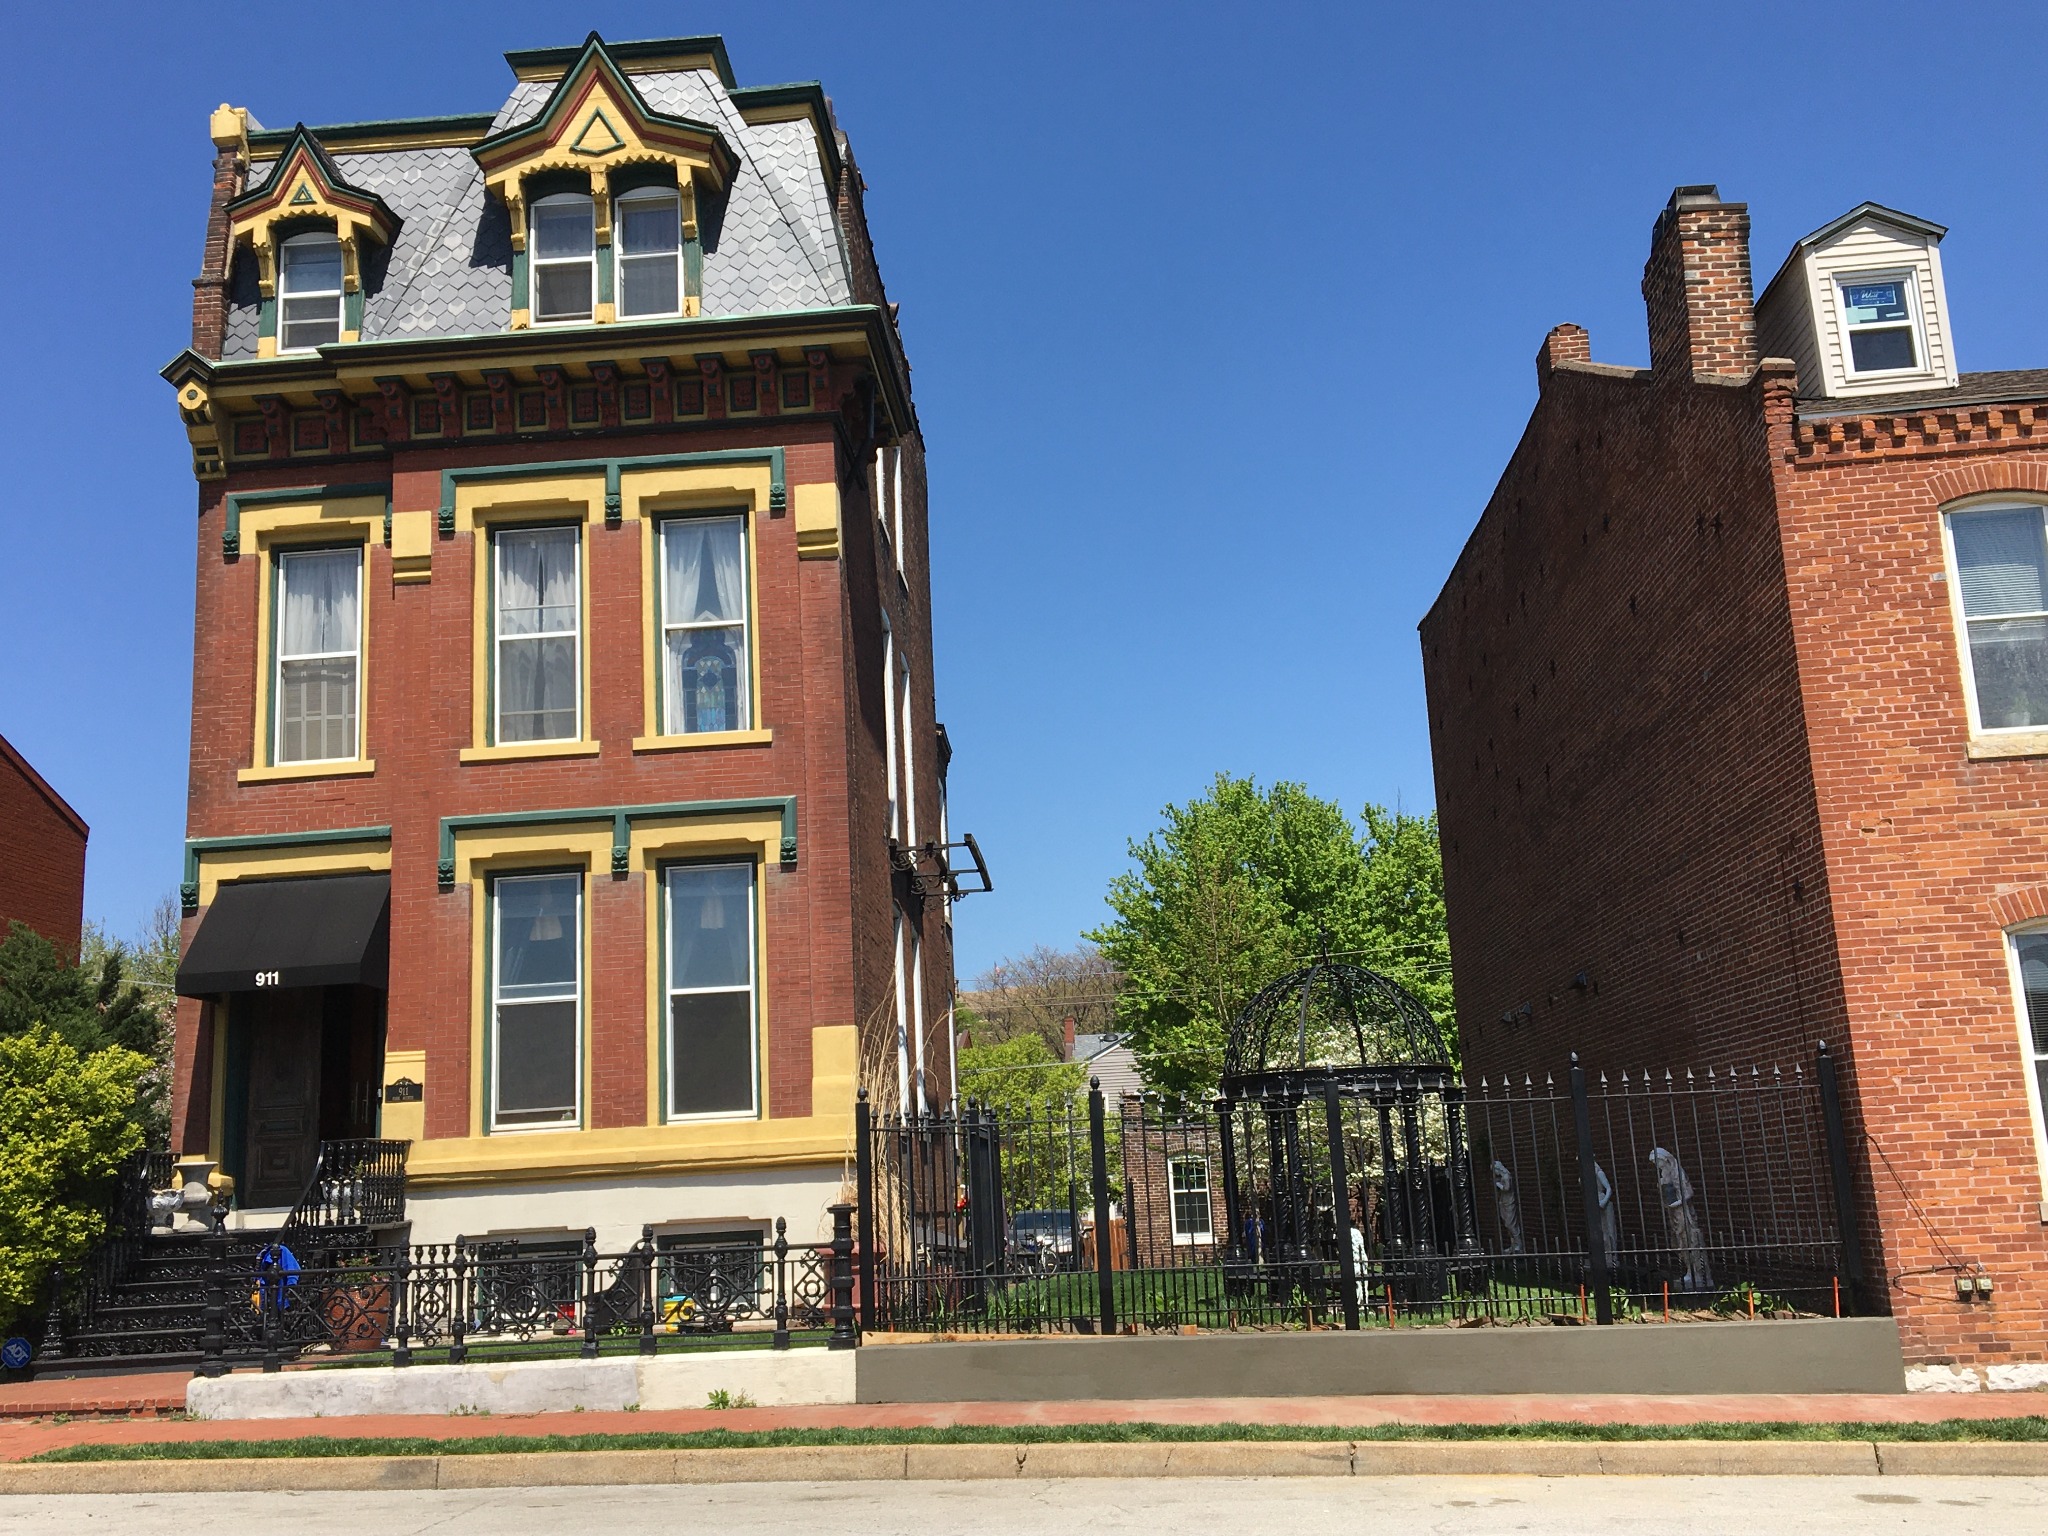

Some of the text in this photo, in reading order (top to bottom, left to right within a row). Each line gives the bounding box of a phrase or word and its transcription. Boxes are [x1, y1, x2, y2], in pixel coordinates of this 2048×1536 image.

[255, 970, 279, 987] 911
[398, 1086, 409, 1096] 911
[6, 1343, 29, 1362] ADT
